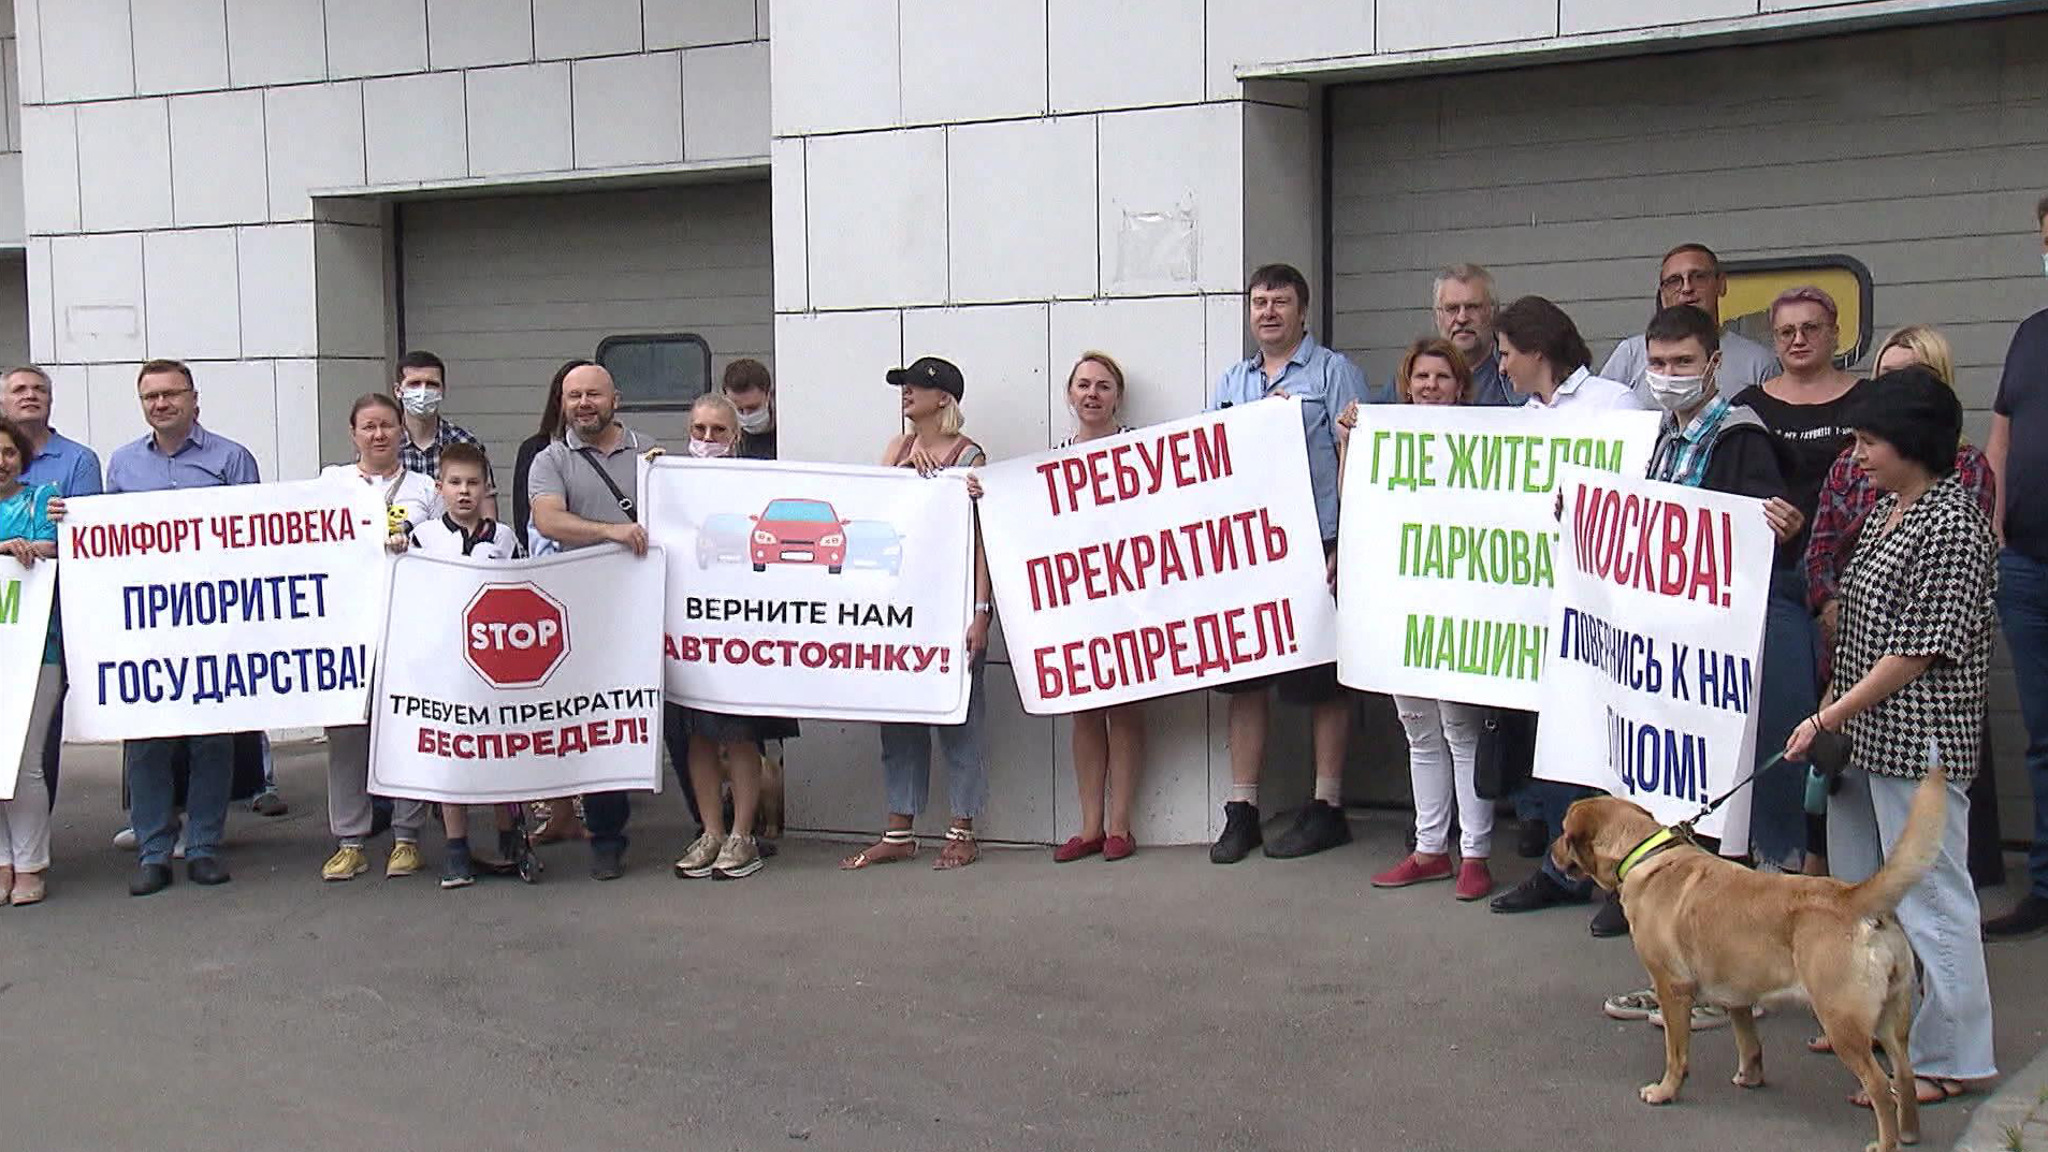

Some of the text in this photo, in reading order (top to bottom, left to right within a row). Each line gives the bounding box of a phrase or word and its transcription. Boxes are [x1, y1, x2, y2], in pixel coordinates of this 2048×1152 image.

[1036, 422, 1234, 516] ТРЕБУЕМ
[1371, 431, 1436, 491] ГДЕ
[71, 517, 204, 559] КОМФОРТ
[211, 507, 356, 549] ЧЕЛОВЕКА
[1026, 507, 1289, 612] ПРЕКРАТИТЬ
[1399, 522, 1559, 589] ПАРКОВА
[1573, 483, 1732, 609] МОСКВА!
[123, 573, 328, 630] ПРИОРИТЕТ
[686, 597, 913, 628] ВЕРНИТЕ НАМ
[470, 619, 557, 650] STOP
[664, 632, 950, 673] АВТОСТОЯНКУ!
[1034, 598, 1299, 700] БЕСПРЕДЕЛ!
[1403, 614, 1548, 682] МАШИН
[98, 644, 366, 705] ГОСУДАРСТВА!
[1672, 641, 1690, 701] К
[390, 688, 660, 725] ТРЕБУЕМ ПРЕКРАТИТ
[417, 717, 648, 759] БЕСПРЕДЕЛ!
